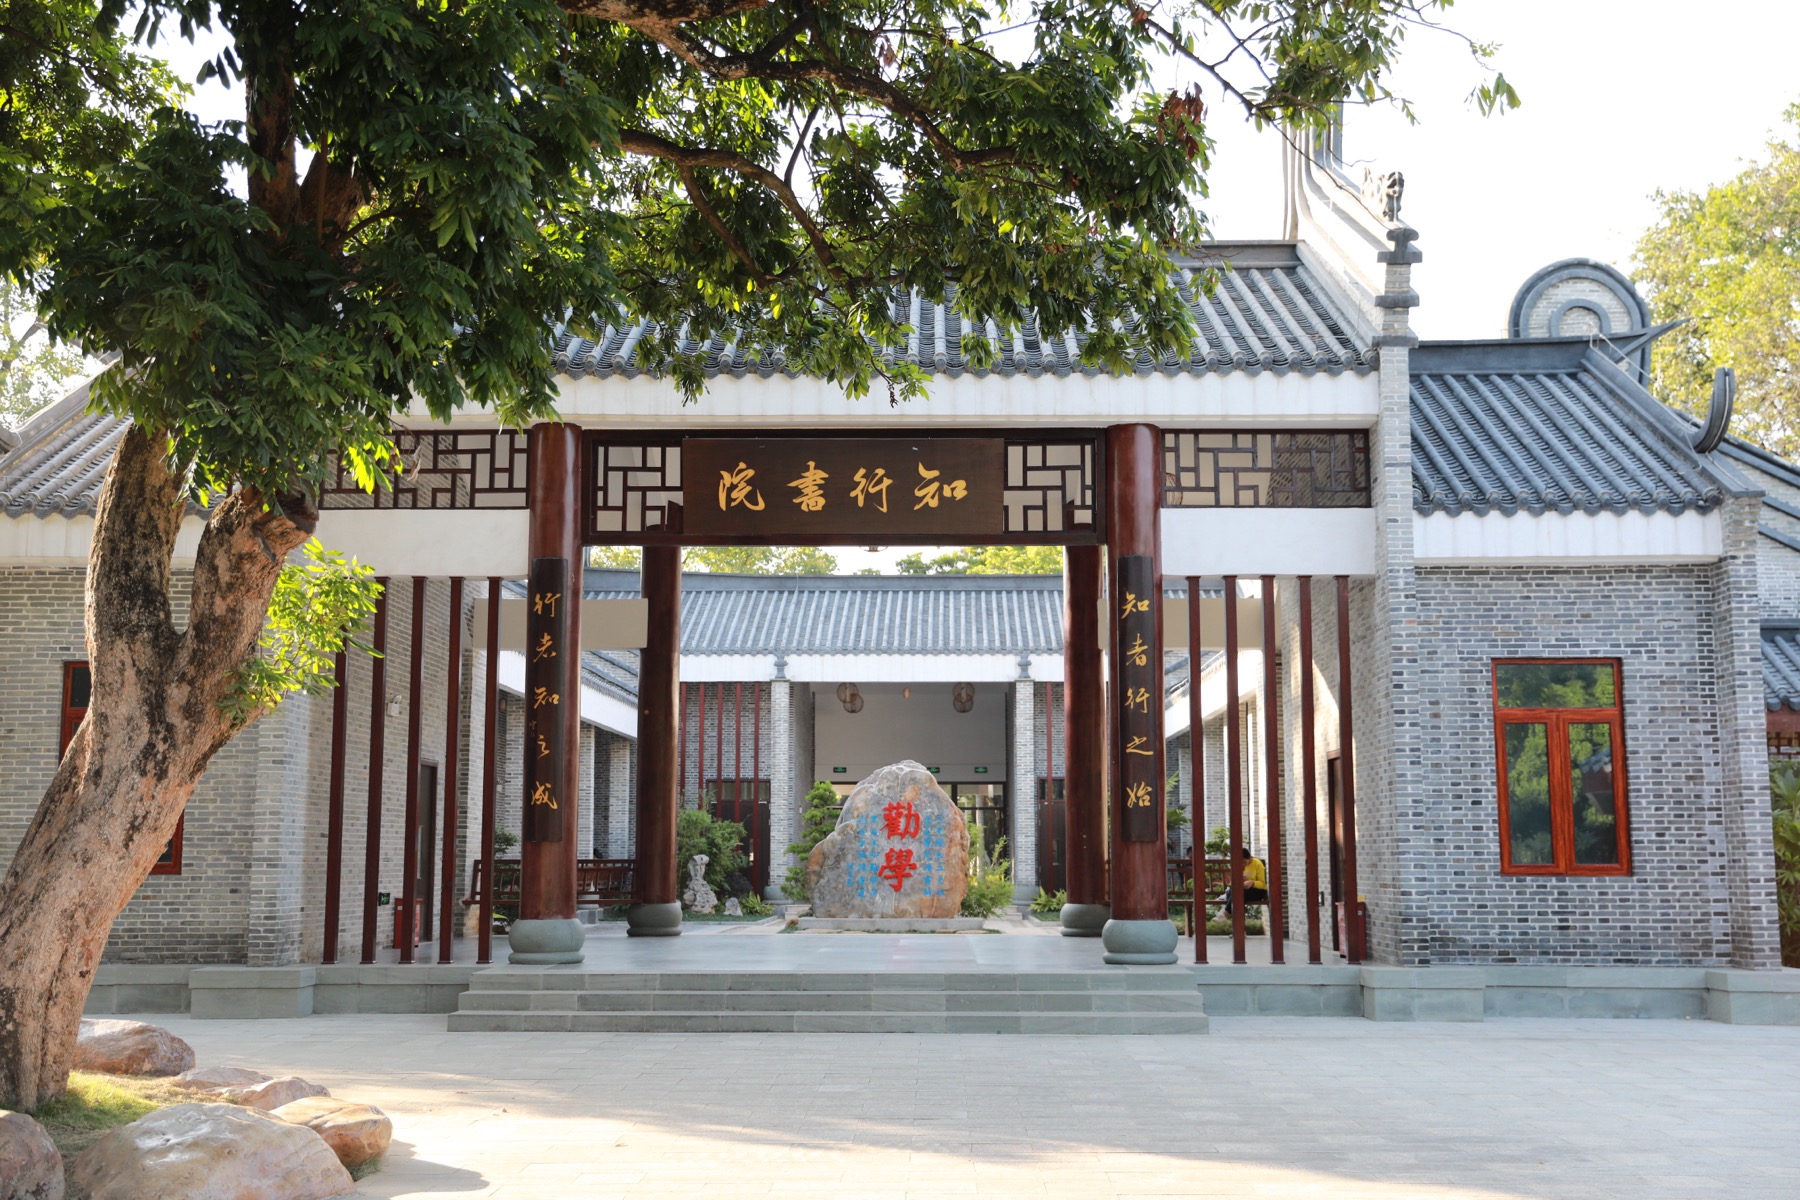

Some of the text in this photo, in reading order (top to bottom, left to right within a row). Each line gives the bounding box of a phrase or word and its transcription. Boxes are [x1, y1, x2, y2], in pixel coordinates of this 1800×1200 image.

[1121, 591, 1154, 809] 知者行之始
